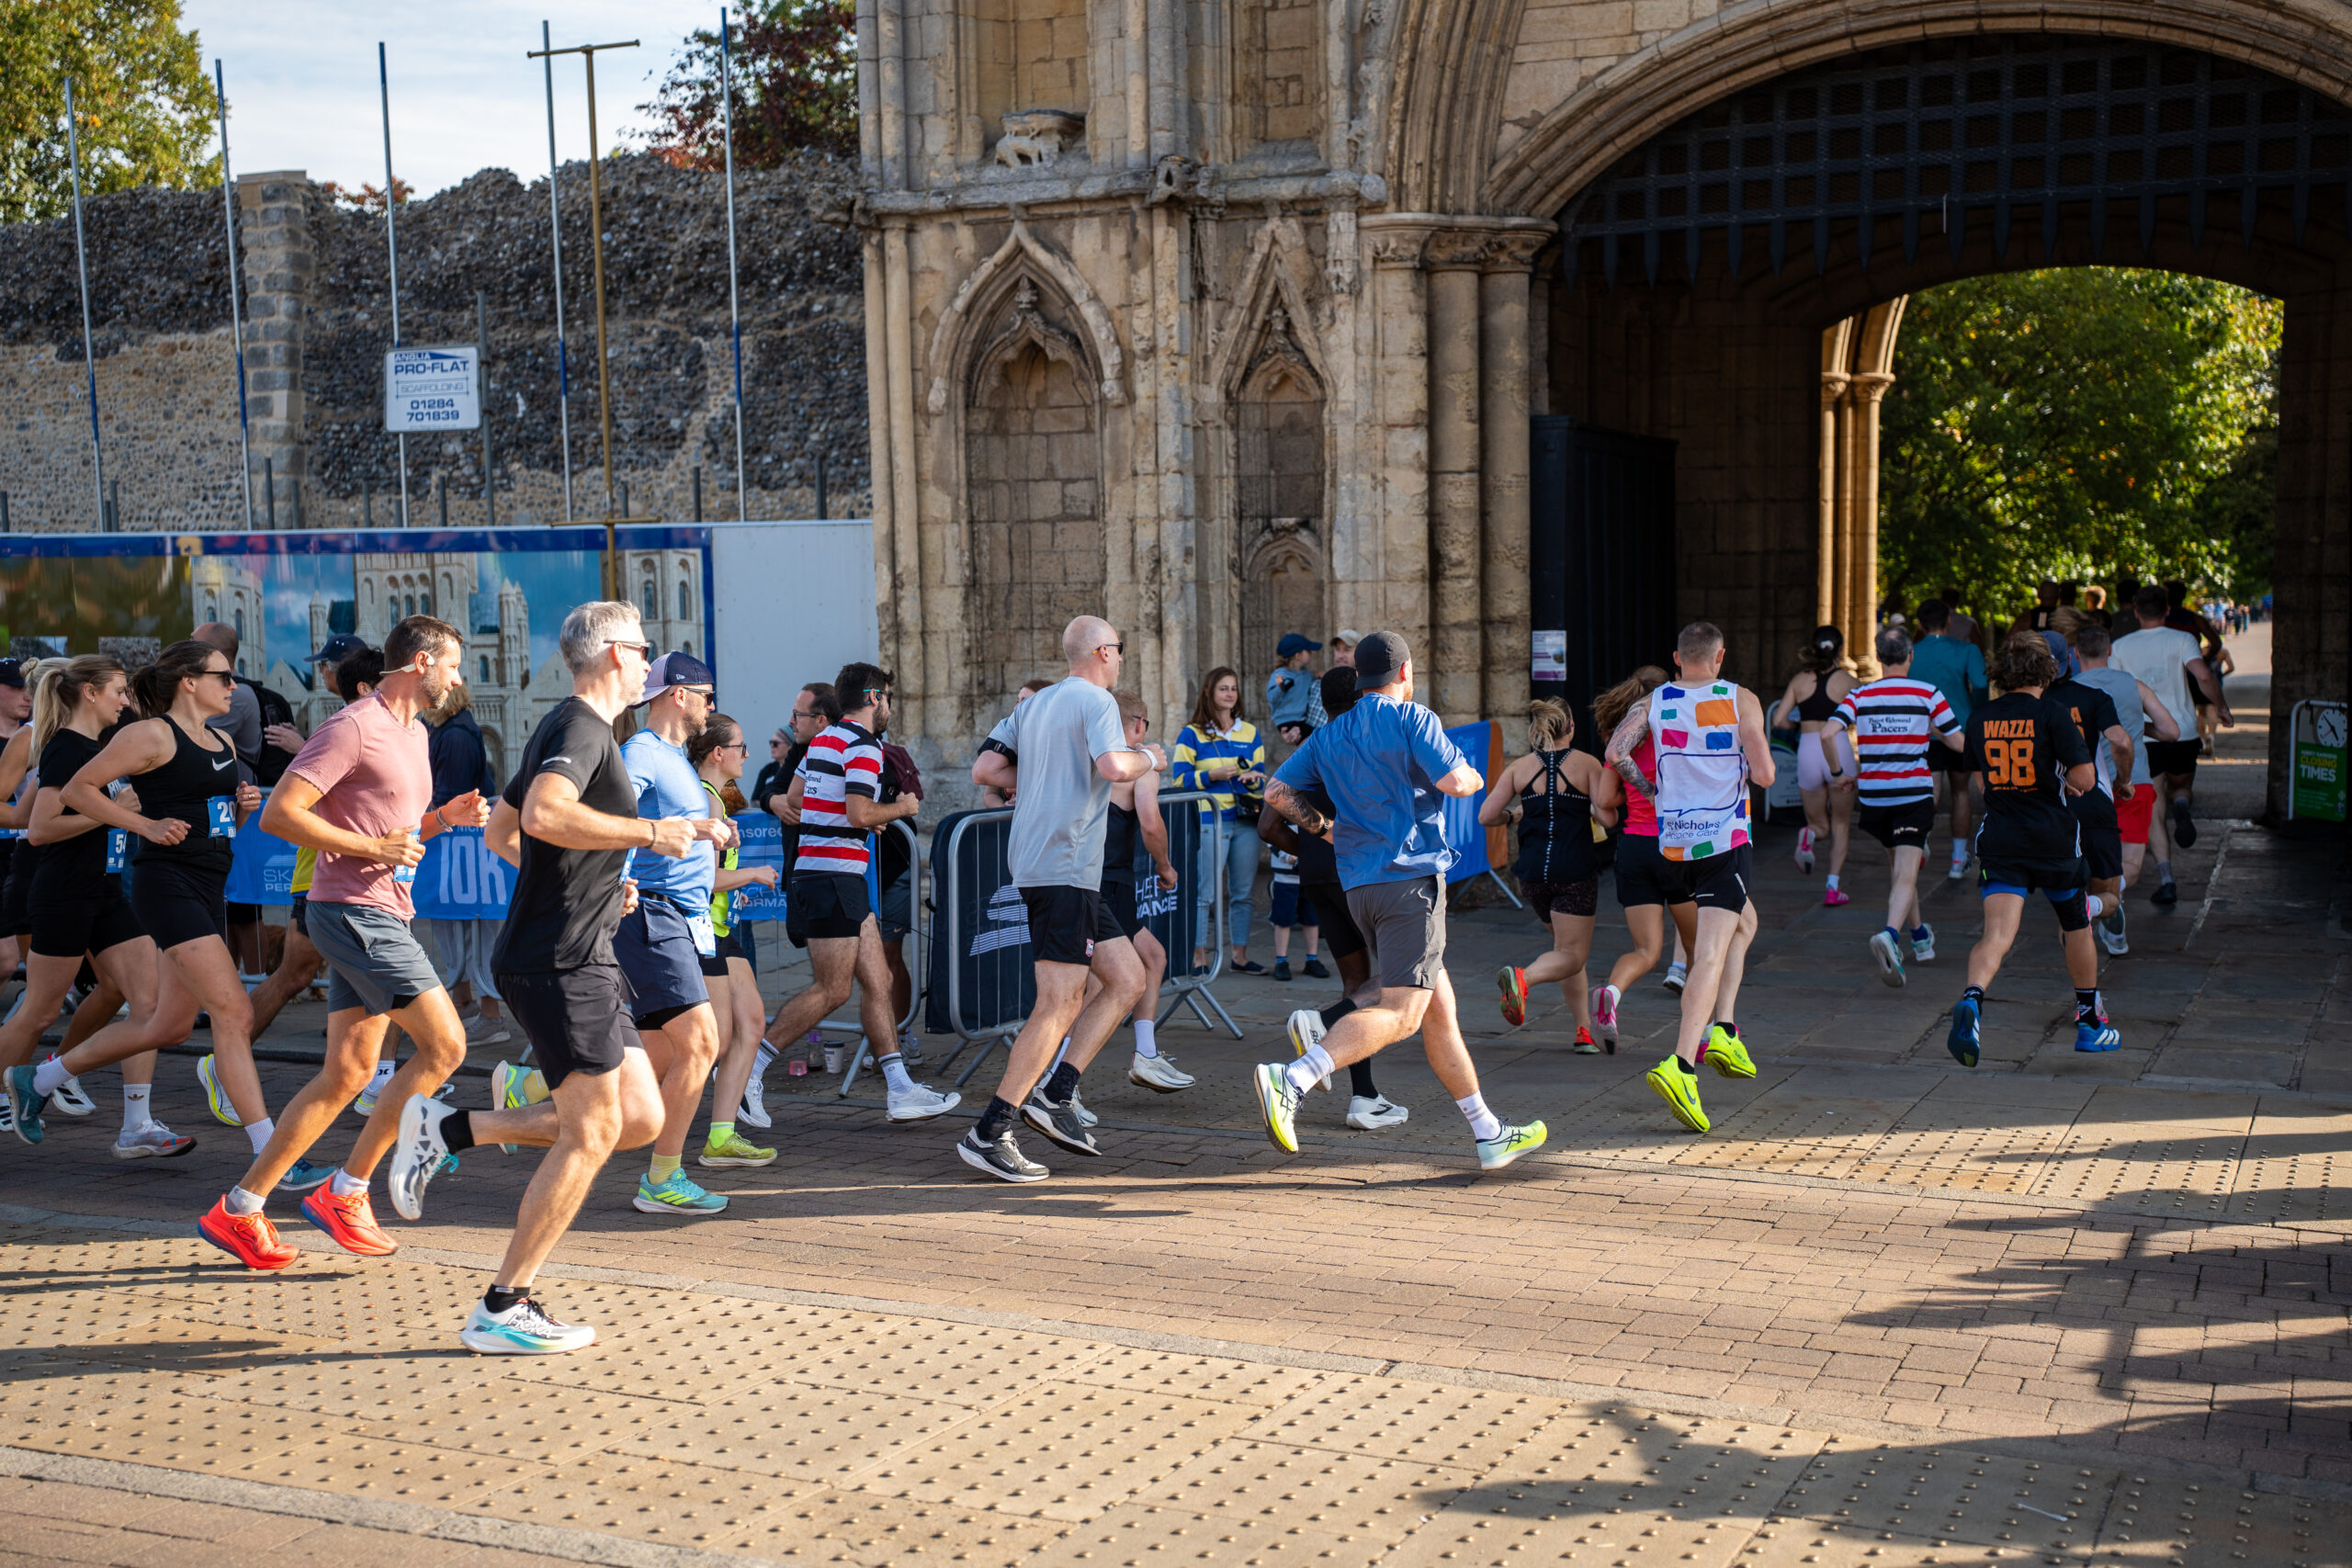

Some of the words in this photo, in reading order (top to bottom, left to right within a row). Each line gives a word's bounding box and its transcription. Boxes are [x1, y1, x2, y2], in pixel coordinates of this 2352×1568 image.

[394, 352, 431, 361] ANGLIA
[394, 360, 469, 376] PRO-FLAT
[401, 382, 463, 392] SCAFFOLDING
[411, 399, 454, 410] 01284
[407, 411, 459, 422] 701839
[1871, 723, 1908, 733] Pacers
[1984, 719, 2035, 739] WAZZA
[1984, 739, 2036, 786] 98
[2300, 755, 2337, 769] CLOSING
[2300, 763, 2337, 782] TIMES
[1665, 830, 1694, 840] Hospice
[1696, 829, 1720, 838] Care
